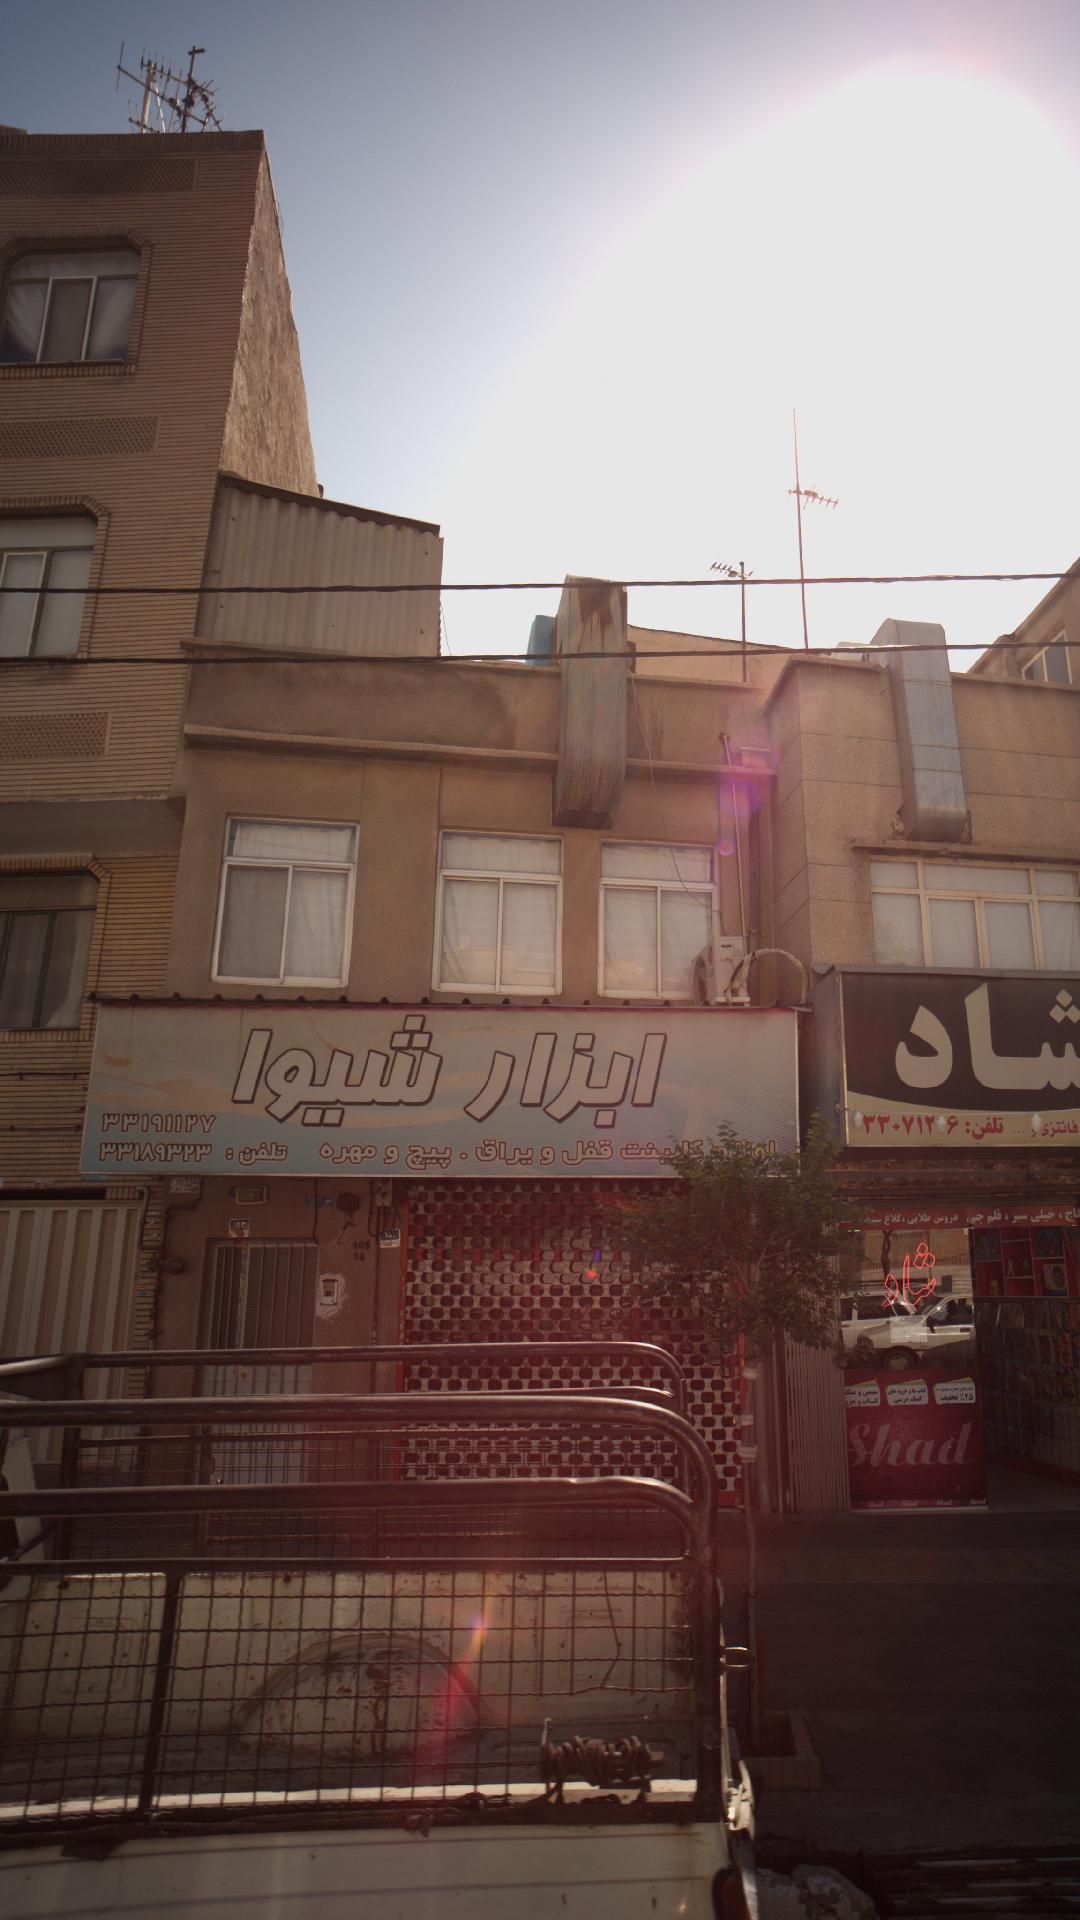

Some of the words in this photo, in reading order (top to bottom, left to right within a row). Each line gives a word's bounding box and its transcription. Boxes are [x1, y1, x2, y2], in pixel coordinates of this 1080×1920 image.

[231, 1014, 443, 1128] شیوا
[463, 1031, 667, 1129] ابزار
[102, 1113, 216, 1133] ۳۳۱۹۱۱۲۷
[863, 1114, 958, 1136] ۳۳۰۷۱۲۶
[99, 1142, 213, 1163] ۳۳۱۸۹۳۲۳
[319, 1141, 377, 1164] مهره
[383, 1145, 400, 1165] و
[406, 1144, 452, 1171] پیچ
[476, 1139, 534, 1166] یراق
[539, 1145, 556, 1166] و
[561, 1139, 614, 1166] قفل
[848, 1421, 975, 1467] Shad
